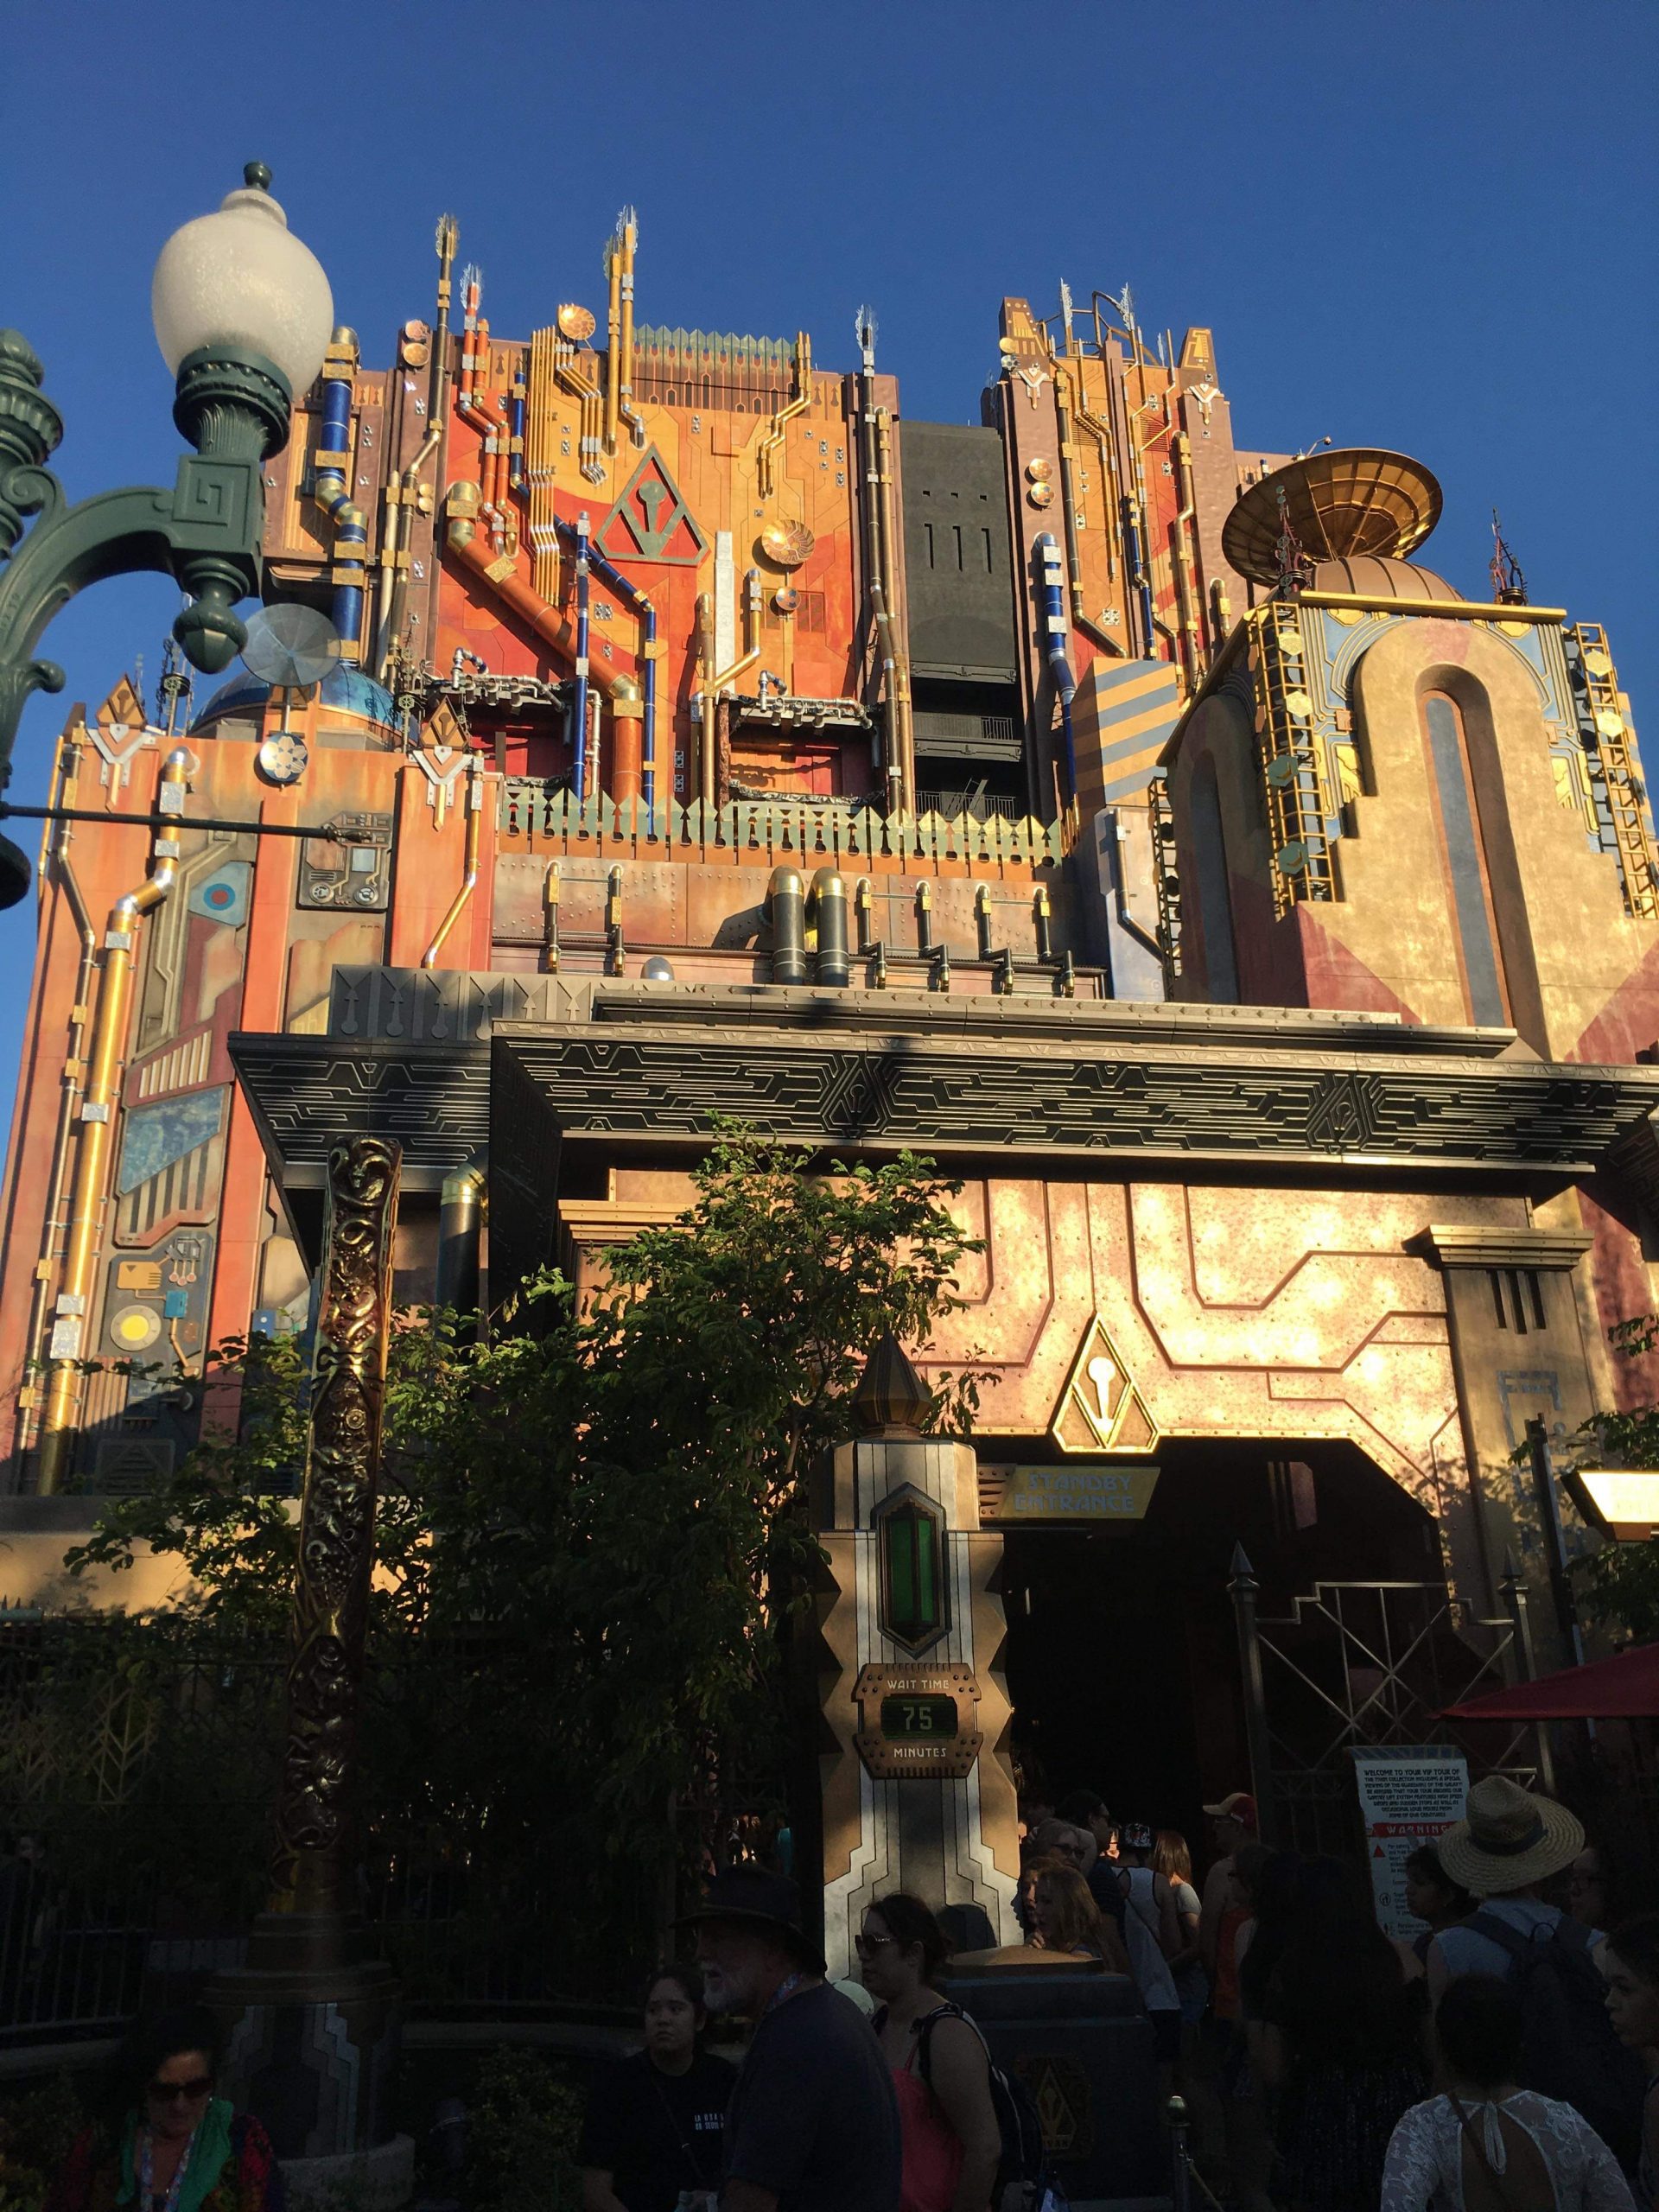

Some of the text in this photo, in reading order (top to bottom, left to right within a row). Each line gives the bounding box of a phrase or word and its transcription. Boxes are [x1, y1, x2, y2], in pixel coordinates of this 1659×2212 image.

[1029, 1472, 1132, 1491] STANDBY
[1015, 1493, 1135, 1512] ENTRANCE
[887, 1679, 950, 1690] WAIT TIME
[903, 1707, 932, 1731] 75
[893, 1747, 947, 1758] MINUTES
